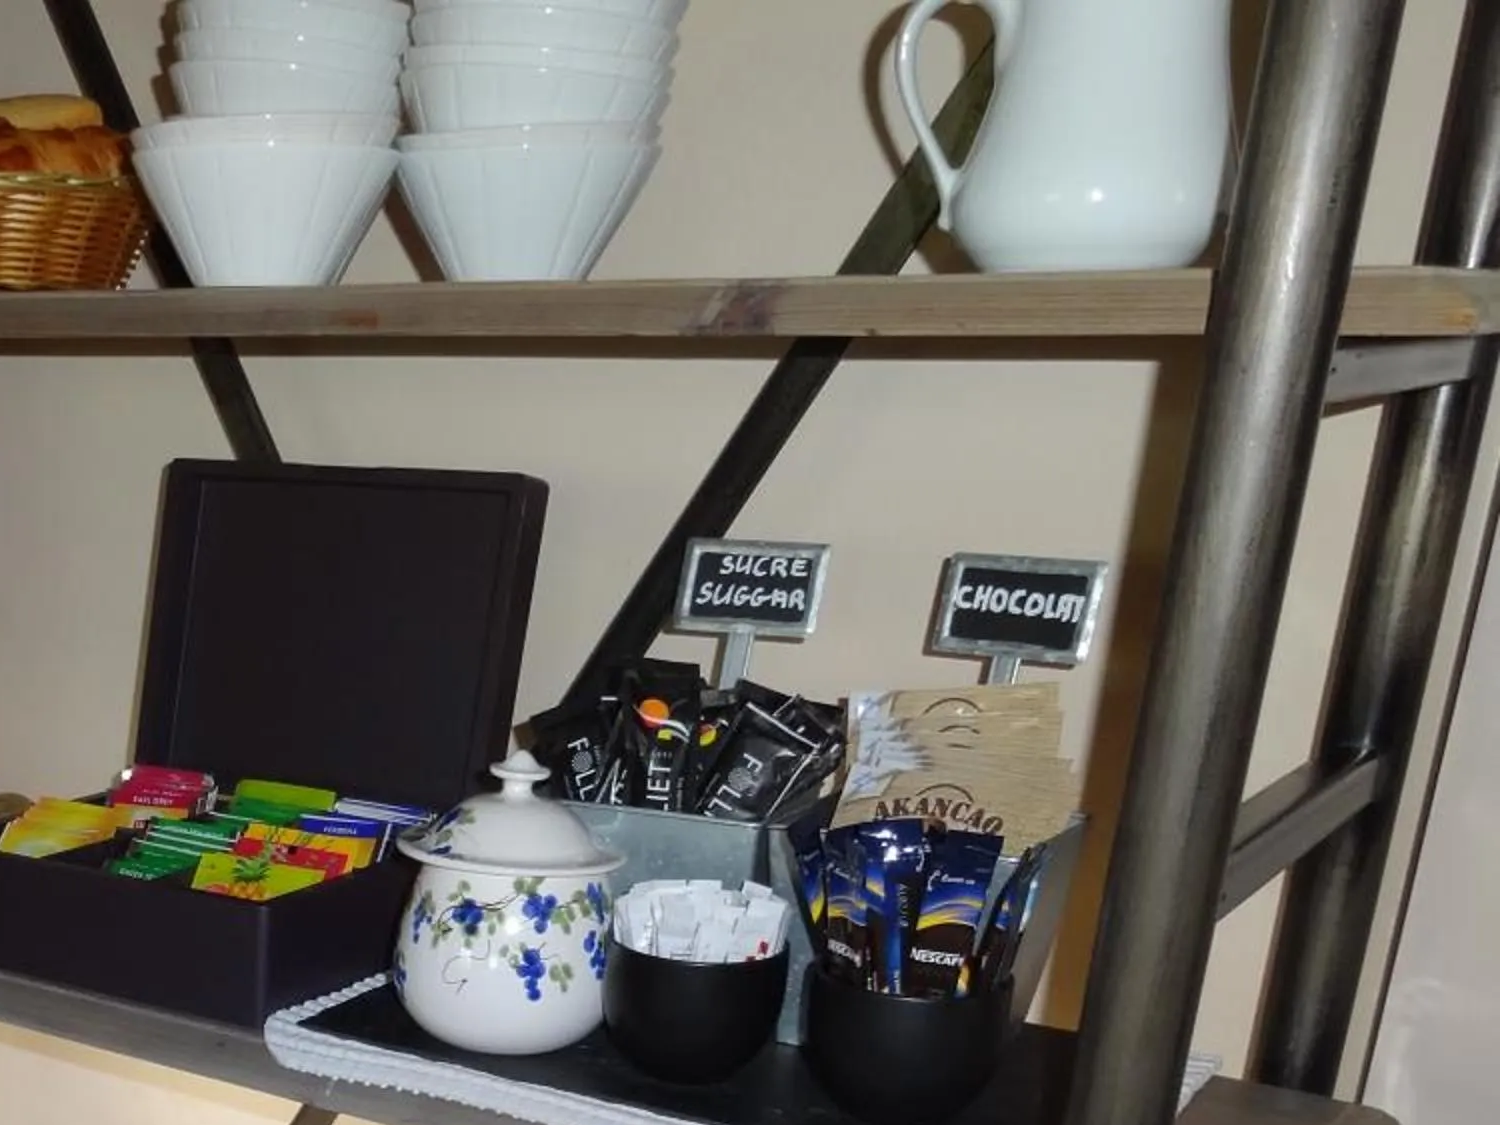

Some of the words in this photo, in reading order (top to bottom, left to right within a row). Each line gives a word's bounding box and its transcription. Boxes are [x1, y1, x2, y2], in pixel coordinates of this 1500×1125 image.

[719, 555, 808, 578] SUCRE
[695, 581, 806, 611] SUGGAR
[954, 584, 1086, 623] CHOCOLAT
